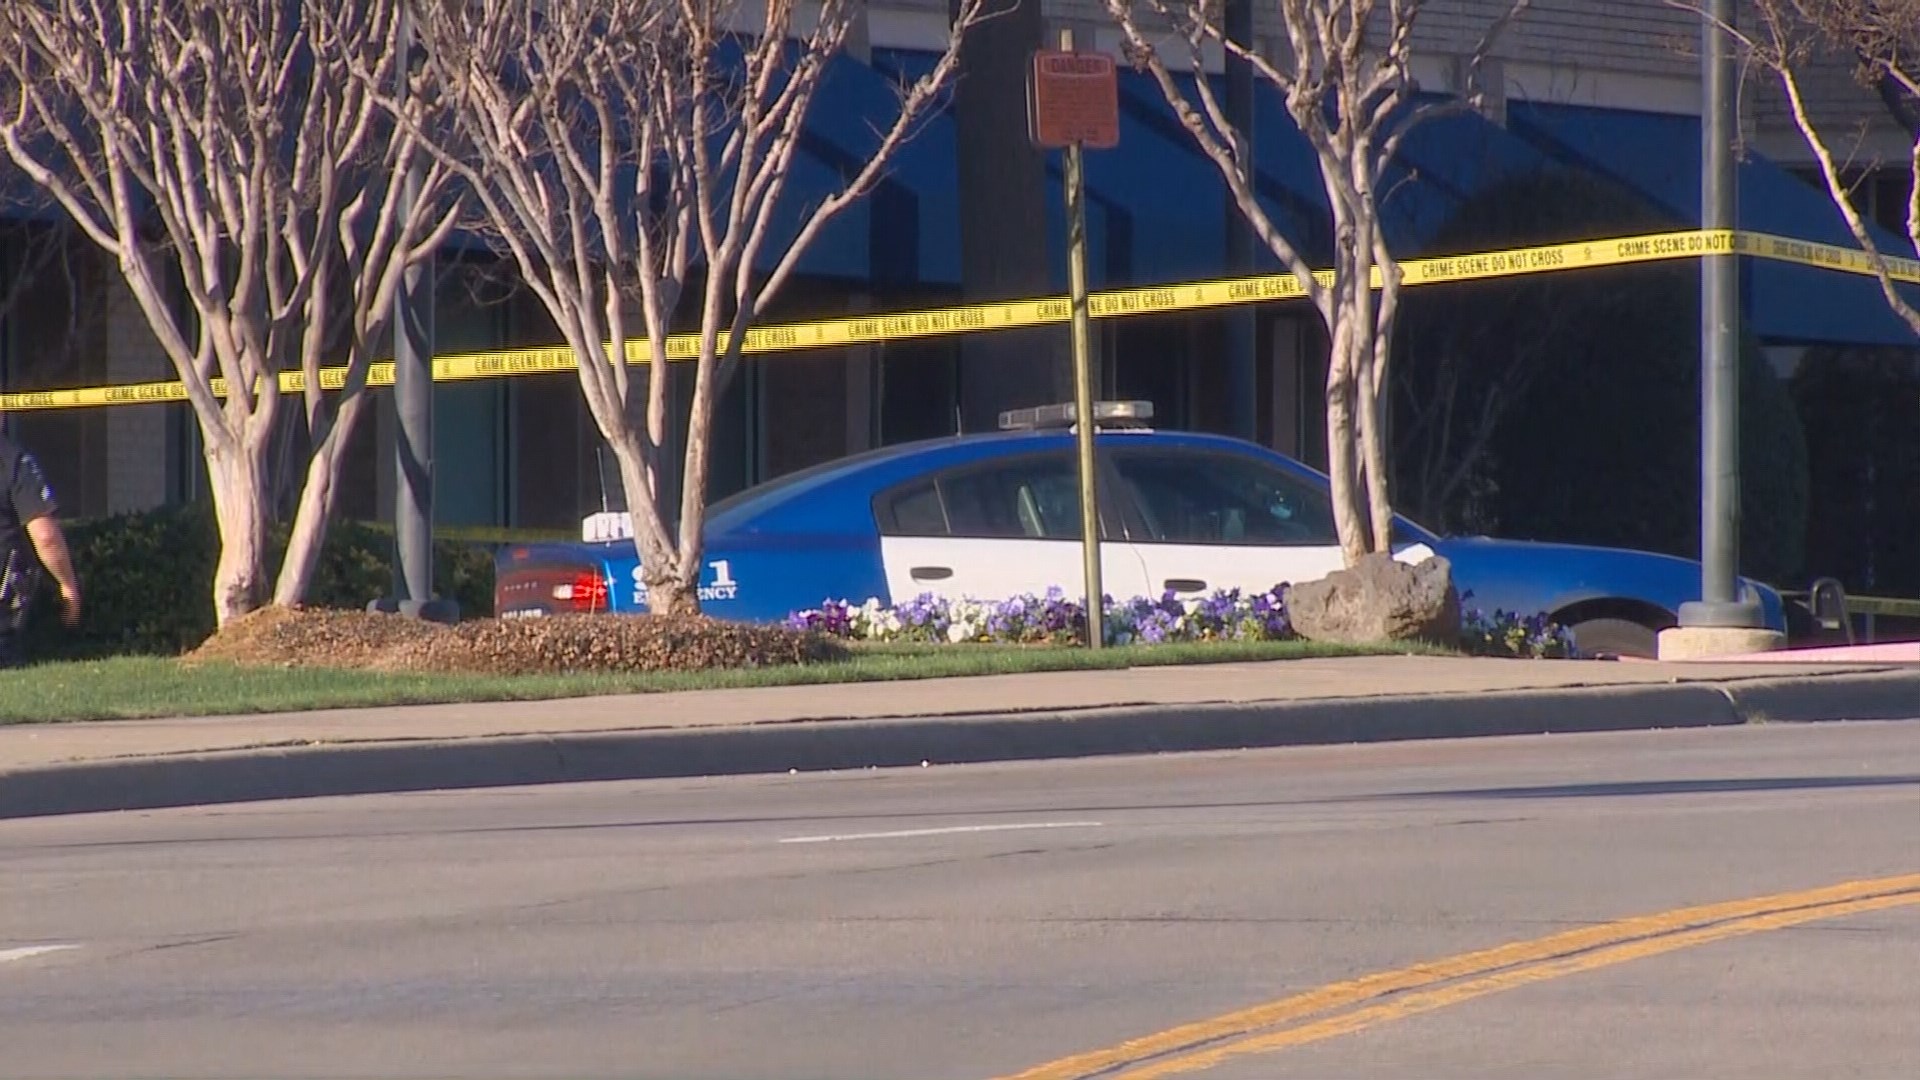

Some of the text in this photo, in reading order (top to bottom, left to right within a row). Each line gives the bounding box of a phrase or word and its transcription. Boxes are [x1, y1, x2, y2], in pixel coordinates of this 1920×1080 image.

[1618, 242, 1650, 258] CRIME
[1653, 239, 1686, 254] SCENE
[1689, 236, 1702, 251] DO
[1705, 234, 1726, 249] NOT
[1422, 250, 1564, 278] CRIME SCENE DO NOT CROSS
[1228, 282, 1260, 299] CRIME
[1263, 278, 1295, 295] SCENE
[1037, 301, 1068, 319] CRIME
[1105, 296, 1119, 312] DO
[1122, 293, 1140, 310] NOT
[1143, 289, 1175, 308] CROSS
[848, 309, 985, 337] CRIME SCENE DO NOT CROSS
